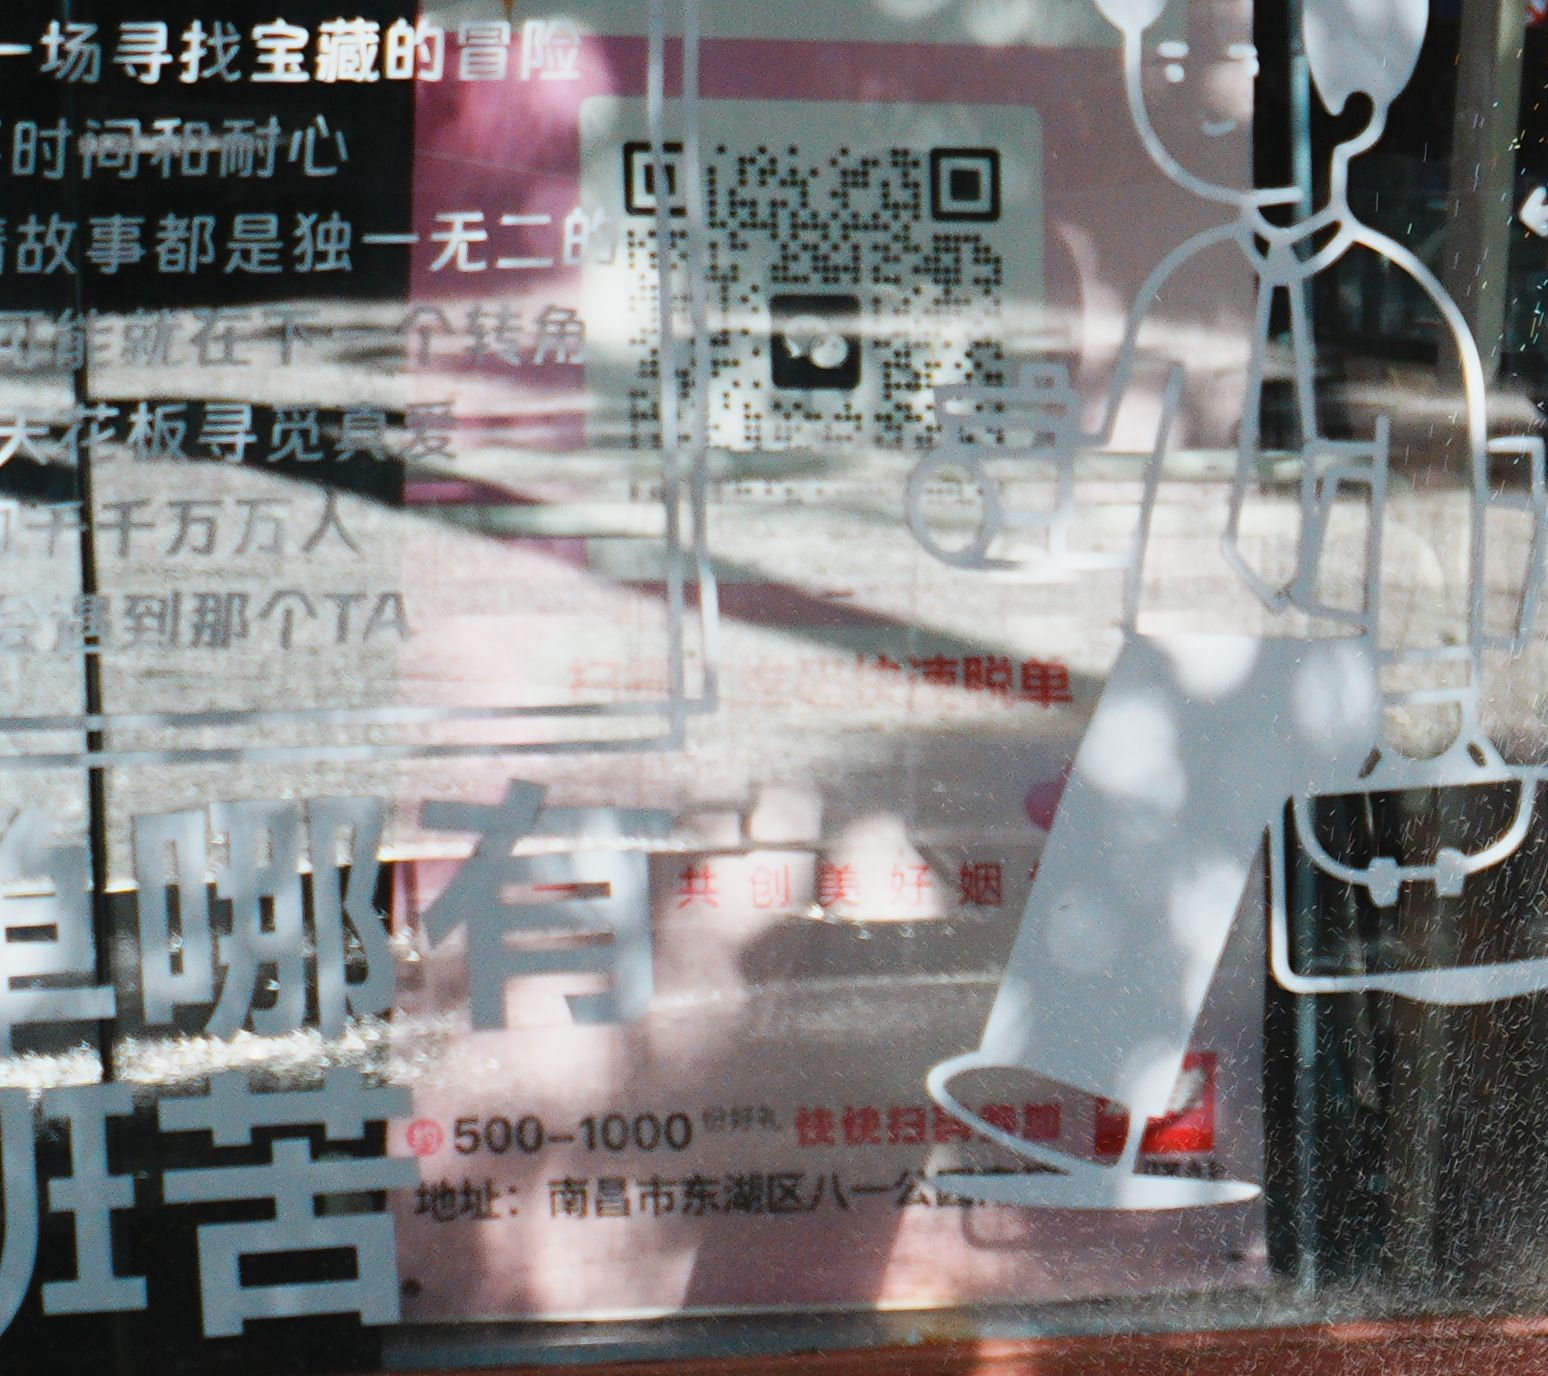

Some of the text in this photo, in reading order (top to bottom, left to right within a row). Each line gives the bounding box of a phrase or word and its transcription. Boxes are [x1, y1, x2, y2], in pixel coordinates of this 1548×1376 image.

[11, 114, 349, 180] 时间和耐心
[0, 209, 620, 275] 故事都是独一无二的
[677, 862, 1039, 908] 共创美好姻
